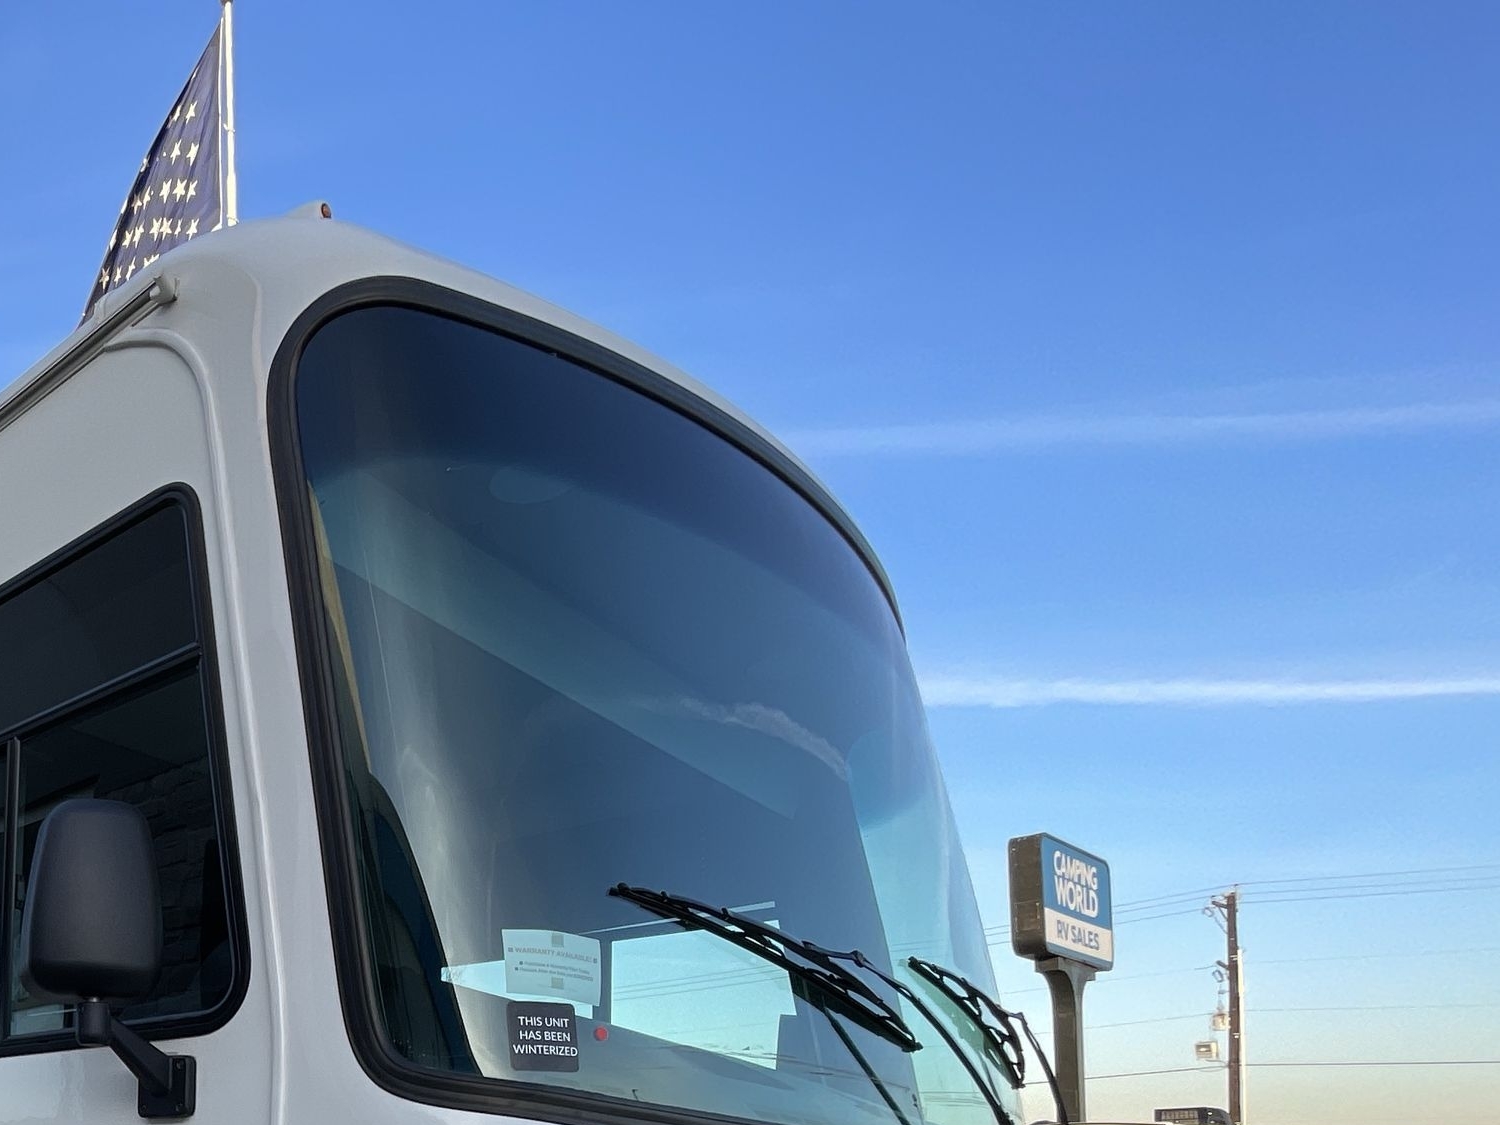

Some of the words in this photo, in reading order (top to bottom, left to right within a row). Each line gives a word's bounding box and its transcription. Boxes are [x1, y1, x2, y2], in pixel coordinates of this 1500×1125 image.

[1053, 850, 1098, 890] CAMPING
[1054, 875, 1098, 918] WORLD
[1056, 919, 1070, 941] RV
[1071, 926, 1100, 951] SALES
[517, 1016, 543, 1026] THIS
[544, 1017, 570, 1028] UNIT
[519, 1030, 542, 1041] HAS
[543, 1031, 571, 1042] BEEN
[512, 1044, 578, 1057] WINTERIZED
